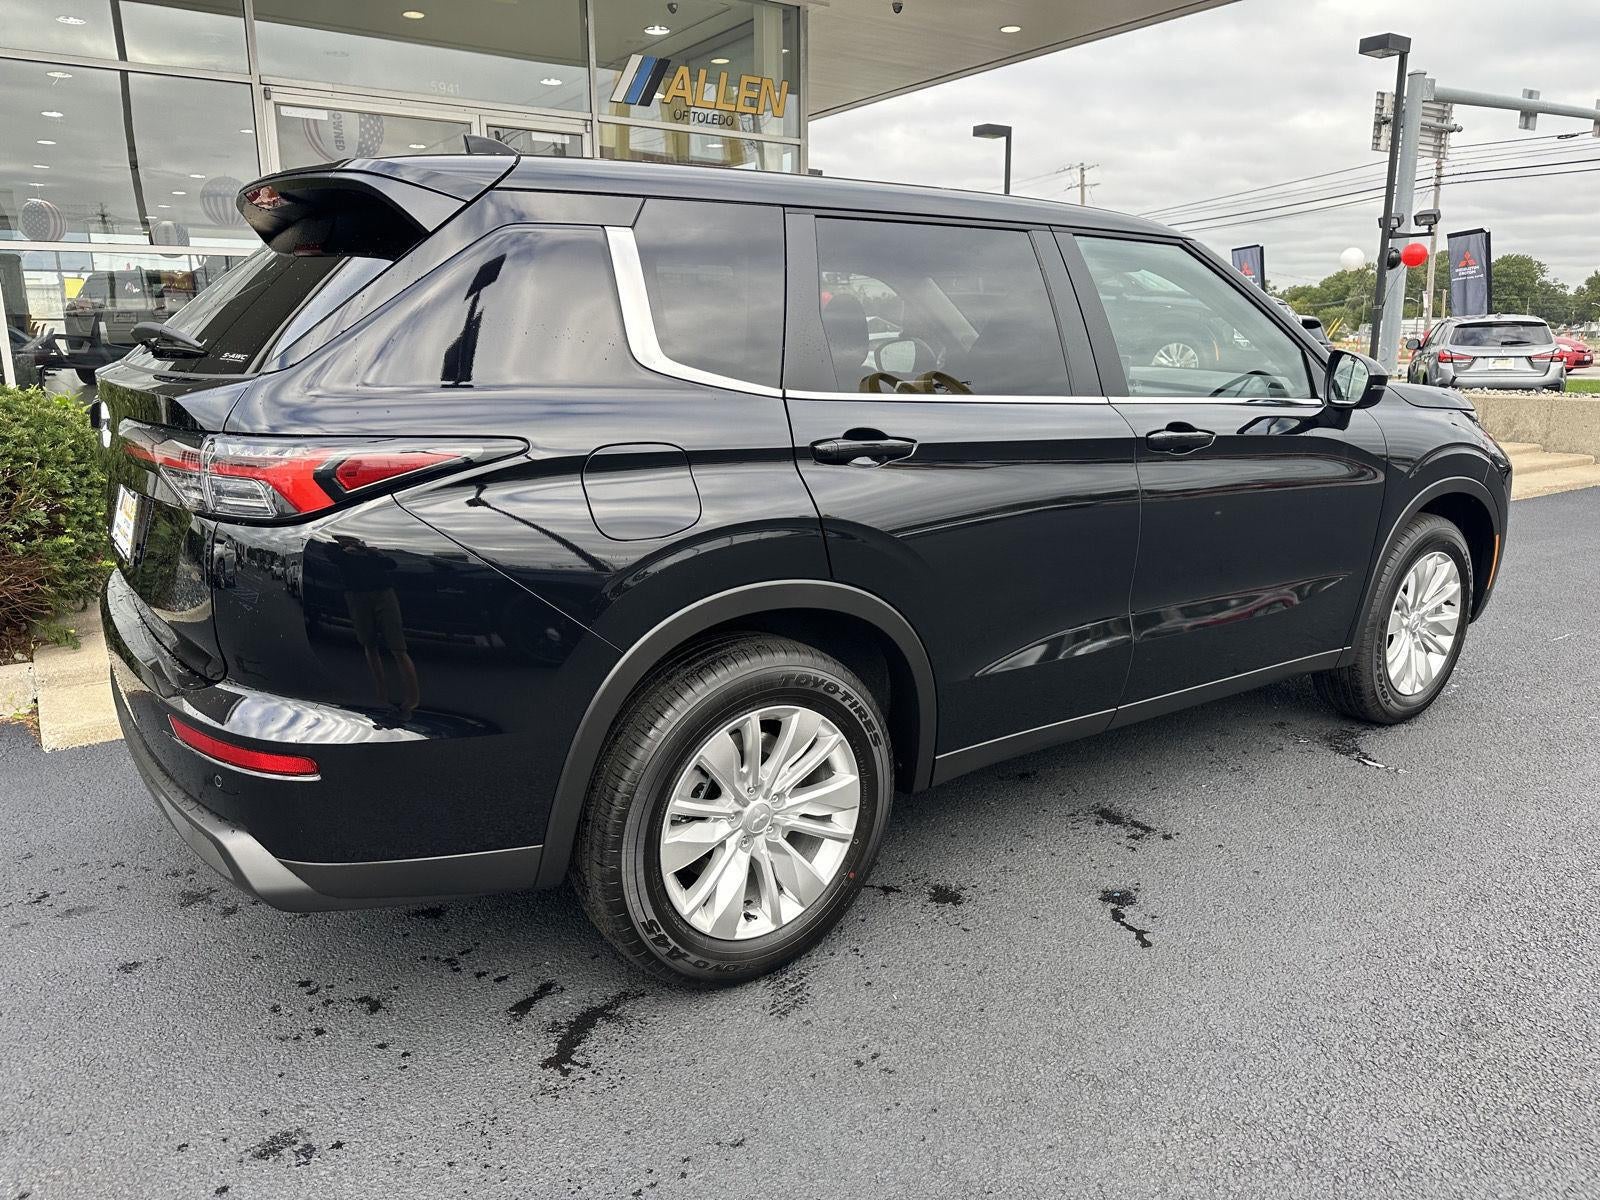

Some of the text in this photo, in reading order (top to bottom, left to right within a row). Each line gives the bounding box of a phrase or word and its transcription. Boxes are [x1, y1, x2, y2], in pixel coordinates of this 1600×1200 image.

[662, 65, 789, 118] ALLEN
[673, 108, 734, 127] OF TOLEDO
